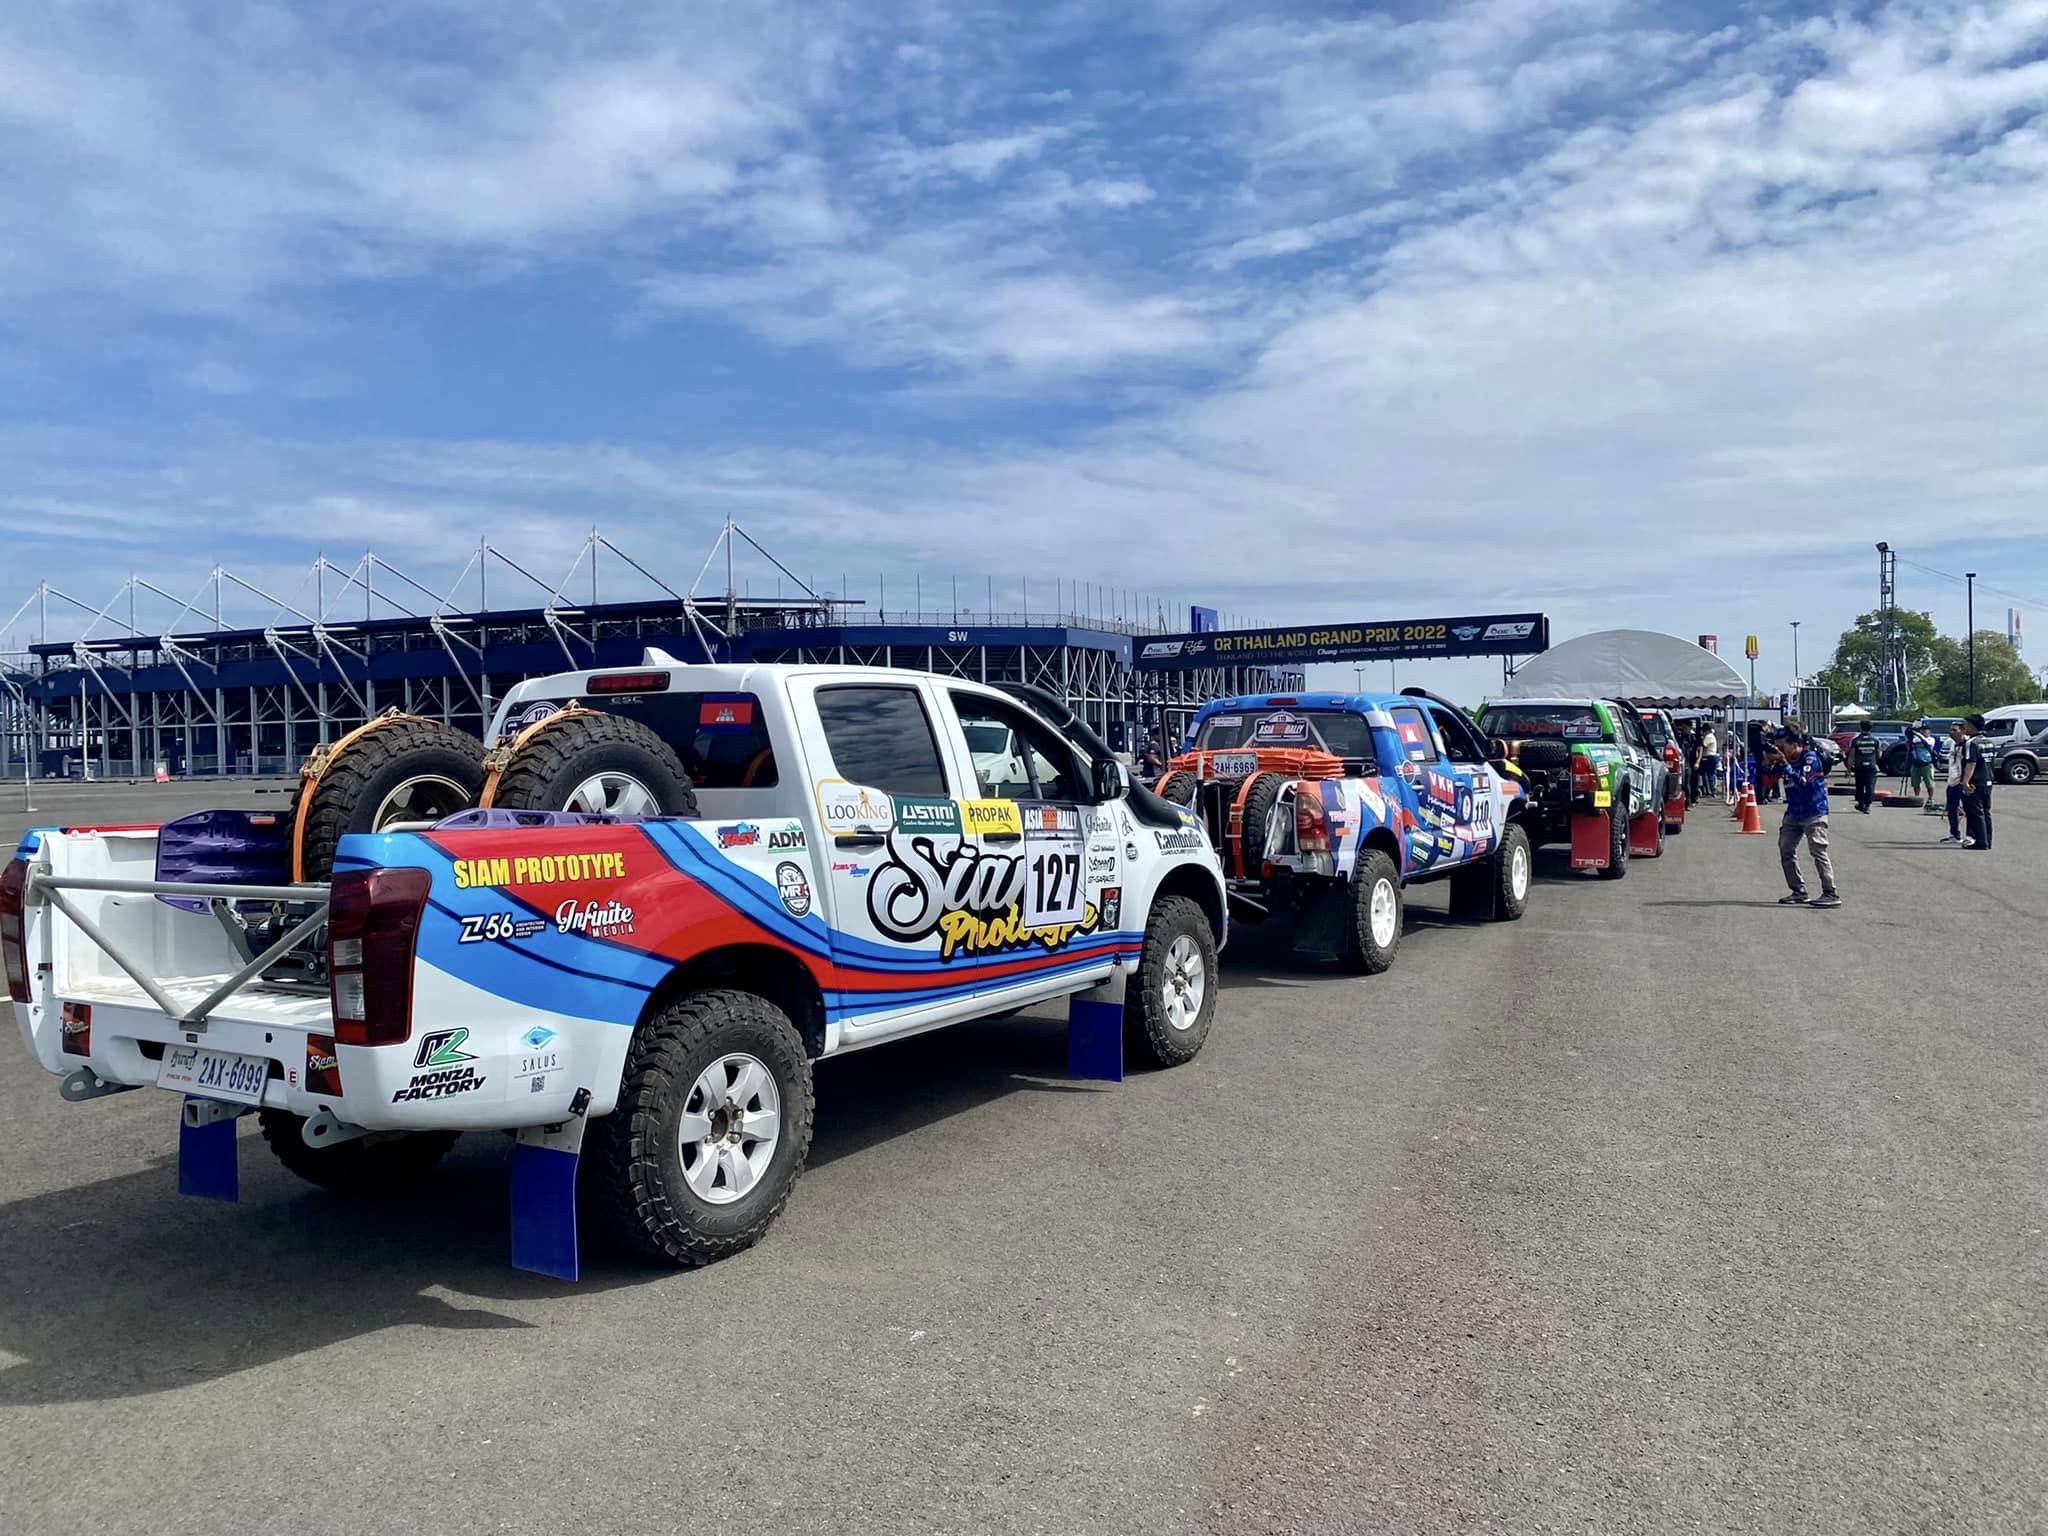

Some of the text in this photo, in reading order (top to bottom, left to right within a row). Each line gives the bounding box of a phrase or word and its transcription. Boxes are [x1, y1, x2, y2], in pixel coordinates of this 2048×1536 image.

[948, 631, 968, 642] SW
[1214, 624, 1447, 651] OR THAILAND GRAND PRIX 2022
[1428, 771, 1454, 794] VKH
[826, 804, 888, 820] LOOKING
[968, 807, 1012, 822] PROPAK
[1024, 809, 1043, 830] ASIA
[1057, 810, 1077, 830] RALLY
[1475, 799, 1489, 831] 110
[768, 832, 806, 848] ADM
[453, 853, 626, 888] SIAM PROTOTYPE
[1575, 858, 1605, 866] TRD
[1033, 853, 1080, 914] 127
[555, 900, 634, 934] Infinite
[592, 923, 634, 937] MEDIA
[522, 1054, 556, 1072] SALUS
[198, 1056, 263, 1093] 2AX-6099
[409, 1067, 475, 1088] MONZA
[391, 1076, 487, 1103] FACTORY
